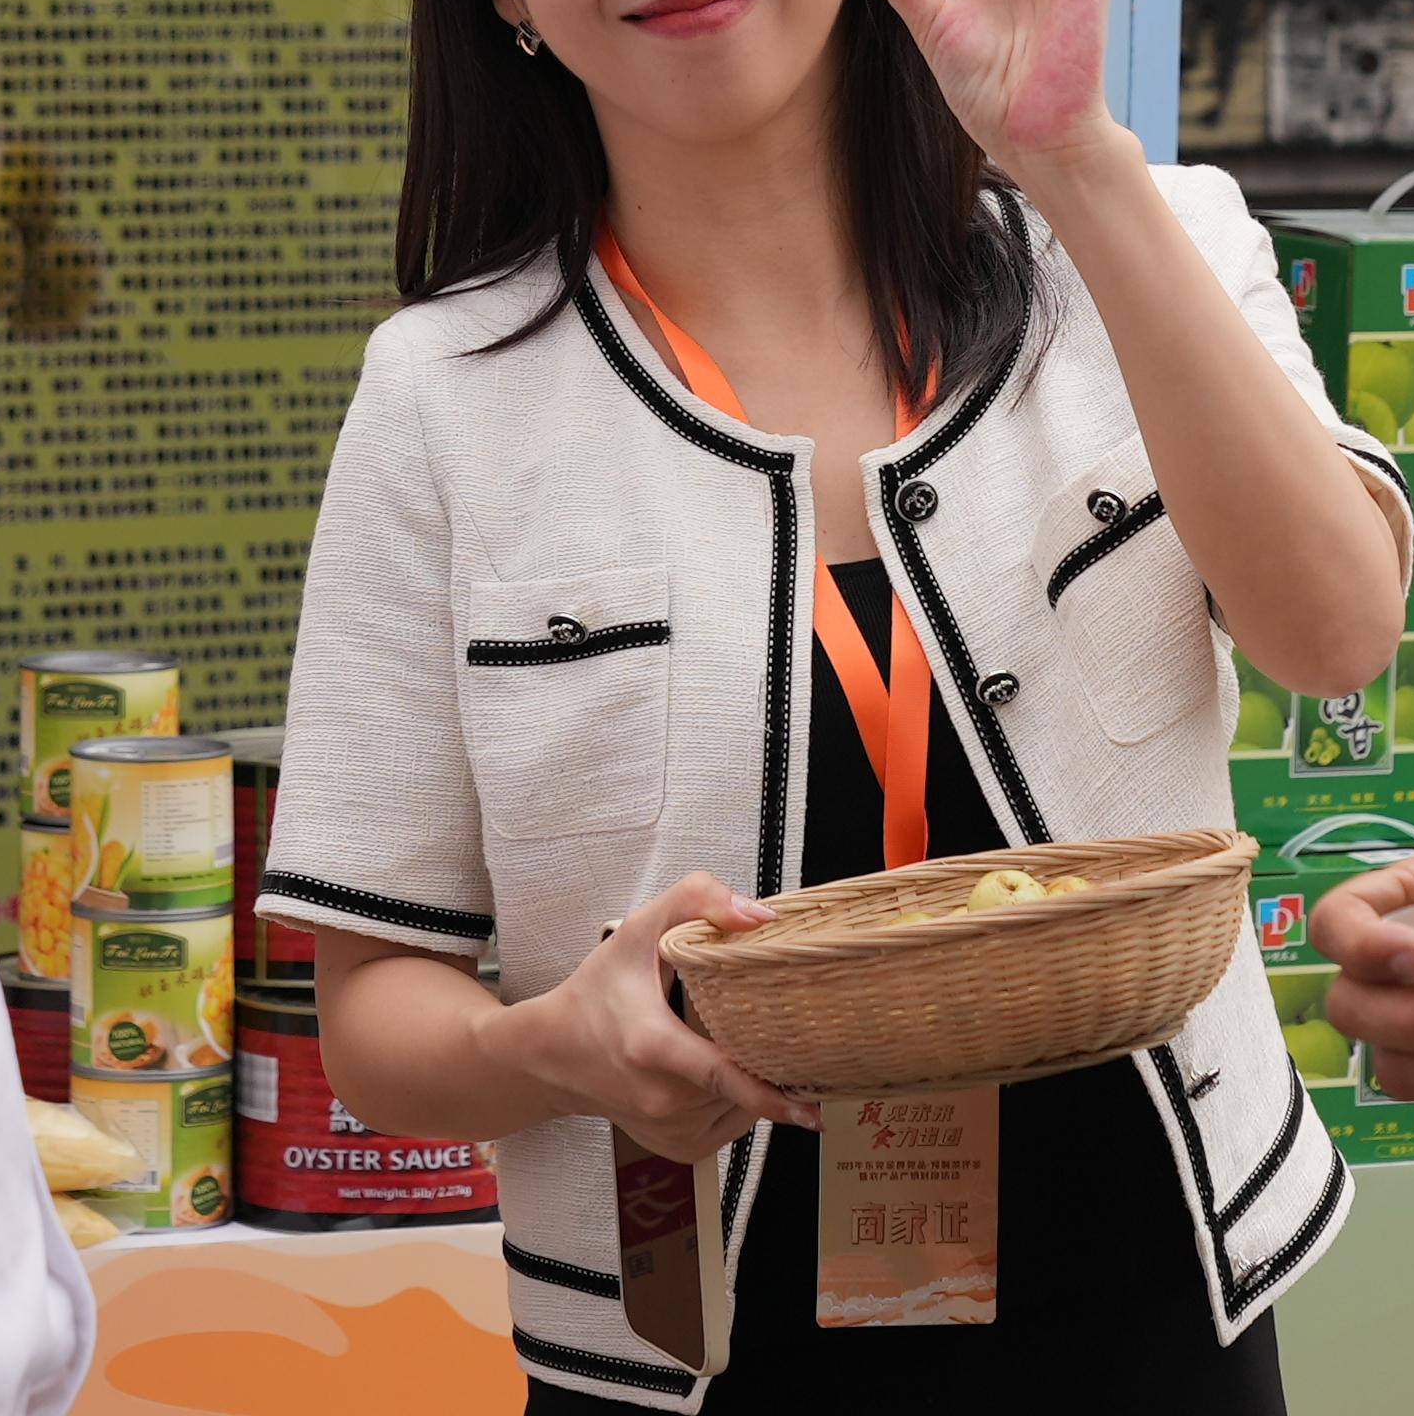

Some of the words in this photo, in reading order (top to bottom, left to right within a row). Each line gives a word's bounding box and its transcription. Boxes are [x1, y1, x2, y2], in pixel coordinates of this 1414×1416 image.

[857, 1101, 956, 1126] 预见未来
[284, 1145, 382, 1172] OYSTER
[389, 1145, 471, 1171] SAUCE
[851, 1201, 969, 1245] 商家证
